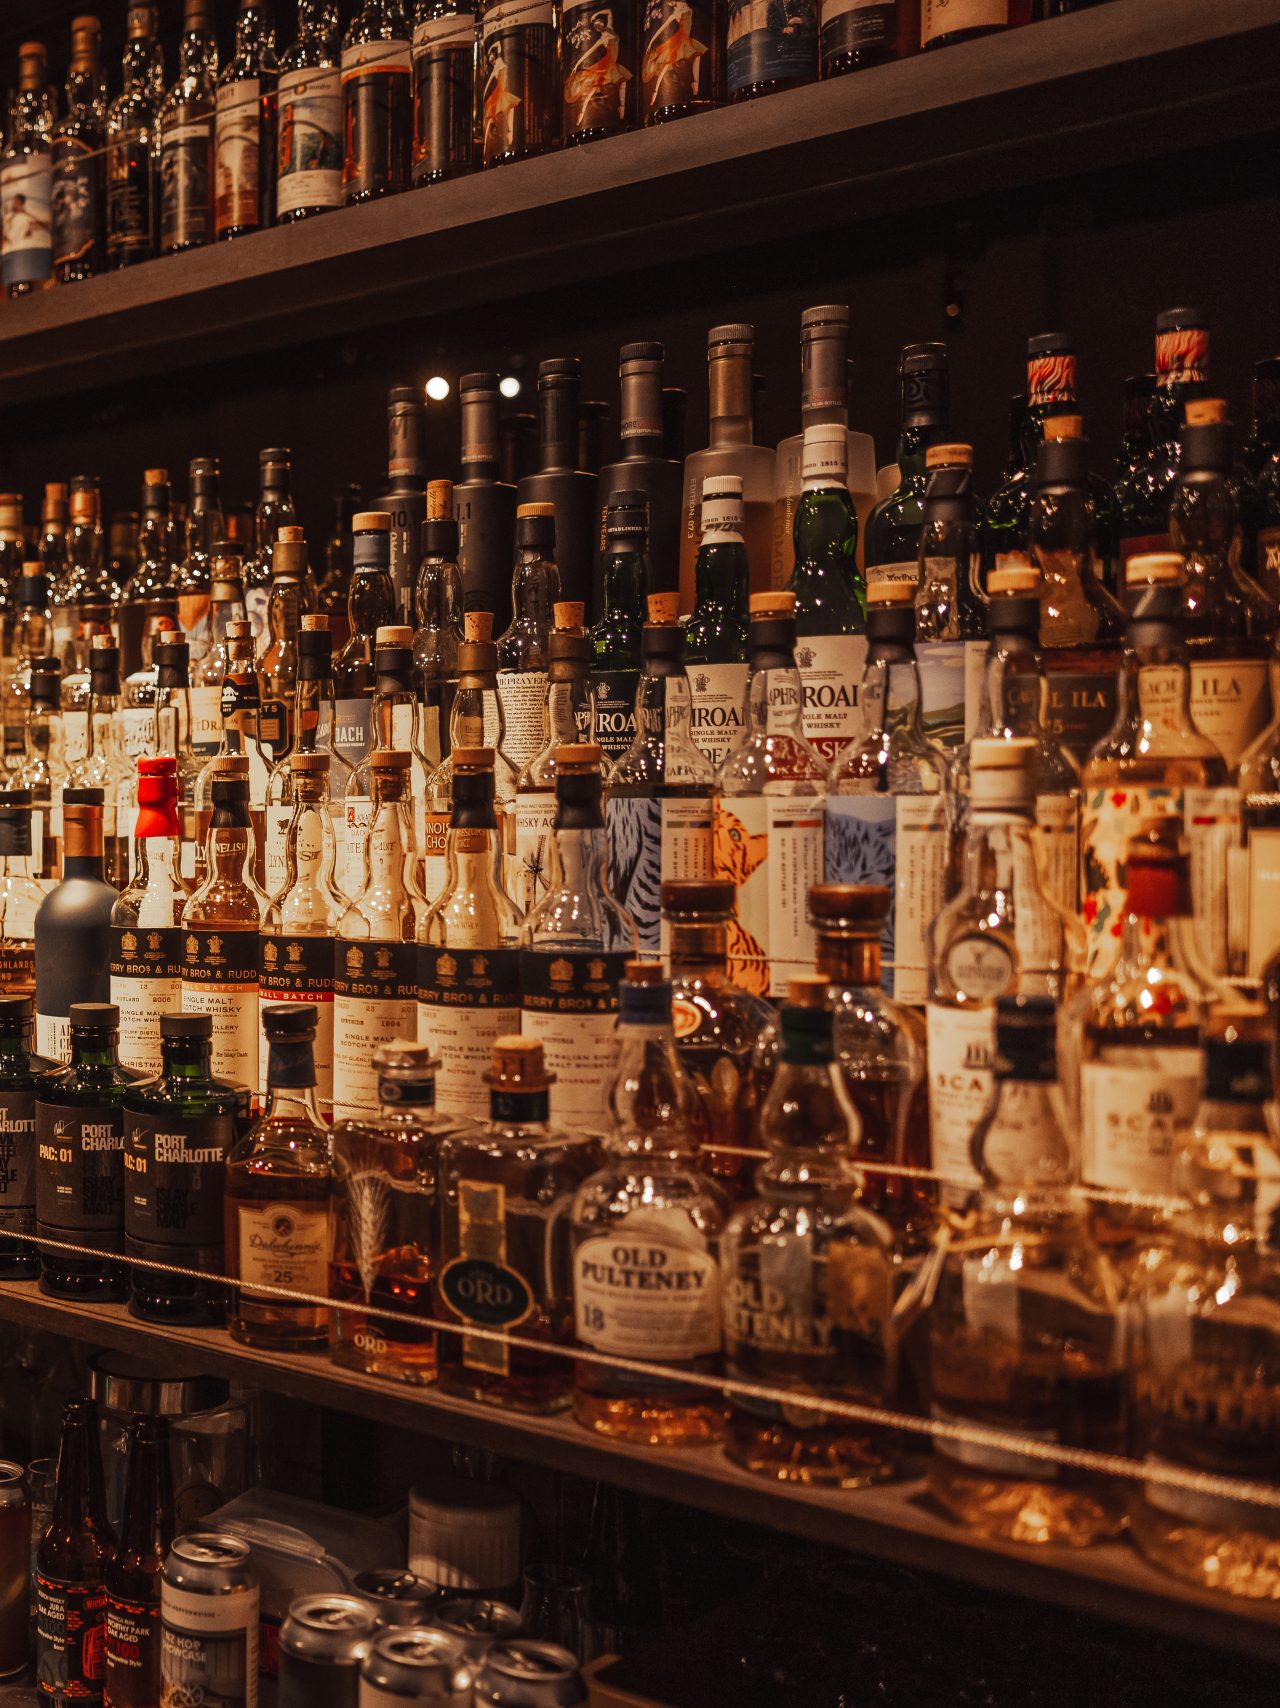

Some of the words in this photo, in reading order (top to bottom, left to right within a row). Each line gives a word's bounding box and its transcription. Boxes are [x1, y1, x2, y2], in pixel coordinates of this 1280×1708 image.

[156, 965, 162, 974] &
[168, 965, 180, 974] RU
[216, 970, 222, 978] &
[228, 970, 256, 978] RUDD
[294, 978, 302, 988] &
[384, 985, 392, 994] &
[284, 992, 323, 1000] BATCH
[479, 994, 487, 1004] &
[596, 998, 606, 1009] &
[340, 1040, 366, 1048] SCOTCH
[344, 1034, 370, 1042] SINGLE
[81, 1124, 114, 1138] PORT
[154, 1134, 188, 1149] PORT
[39, 1144, 58, 1161] PAC:
[60, 1148, 72, 1162] 01
[154, 1147, 224, 1164] CHARLOTTE
[136, 1156, 147, 1173] 01
[612, 1246, 668, 1268] OLD
[273, 1270, 293, 1283] 25
[581, 1260, 706, 1291] PULTENEY
[456, 1277, 512, 1306] ORD
[583, 1304, 605, 1331] 18
[354, 1332, 388, 1354] ORD
[49, 1603, 64, 1612] JURA
[47, 1609, 64, 1620] AGED
[108, 1618, 130, 1633] WORTHY
[130, 1626, 150, 1636] PARK
[108, 1626, 118, 1637] OAK
[120, 1630, 138, 1643] AGED
[165, 1630, 176, 1644] NZ
[177, 1637, 200, 1650] HOP
[129, 1659, 142, 1668] Style
